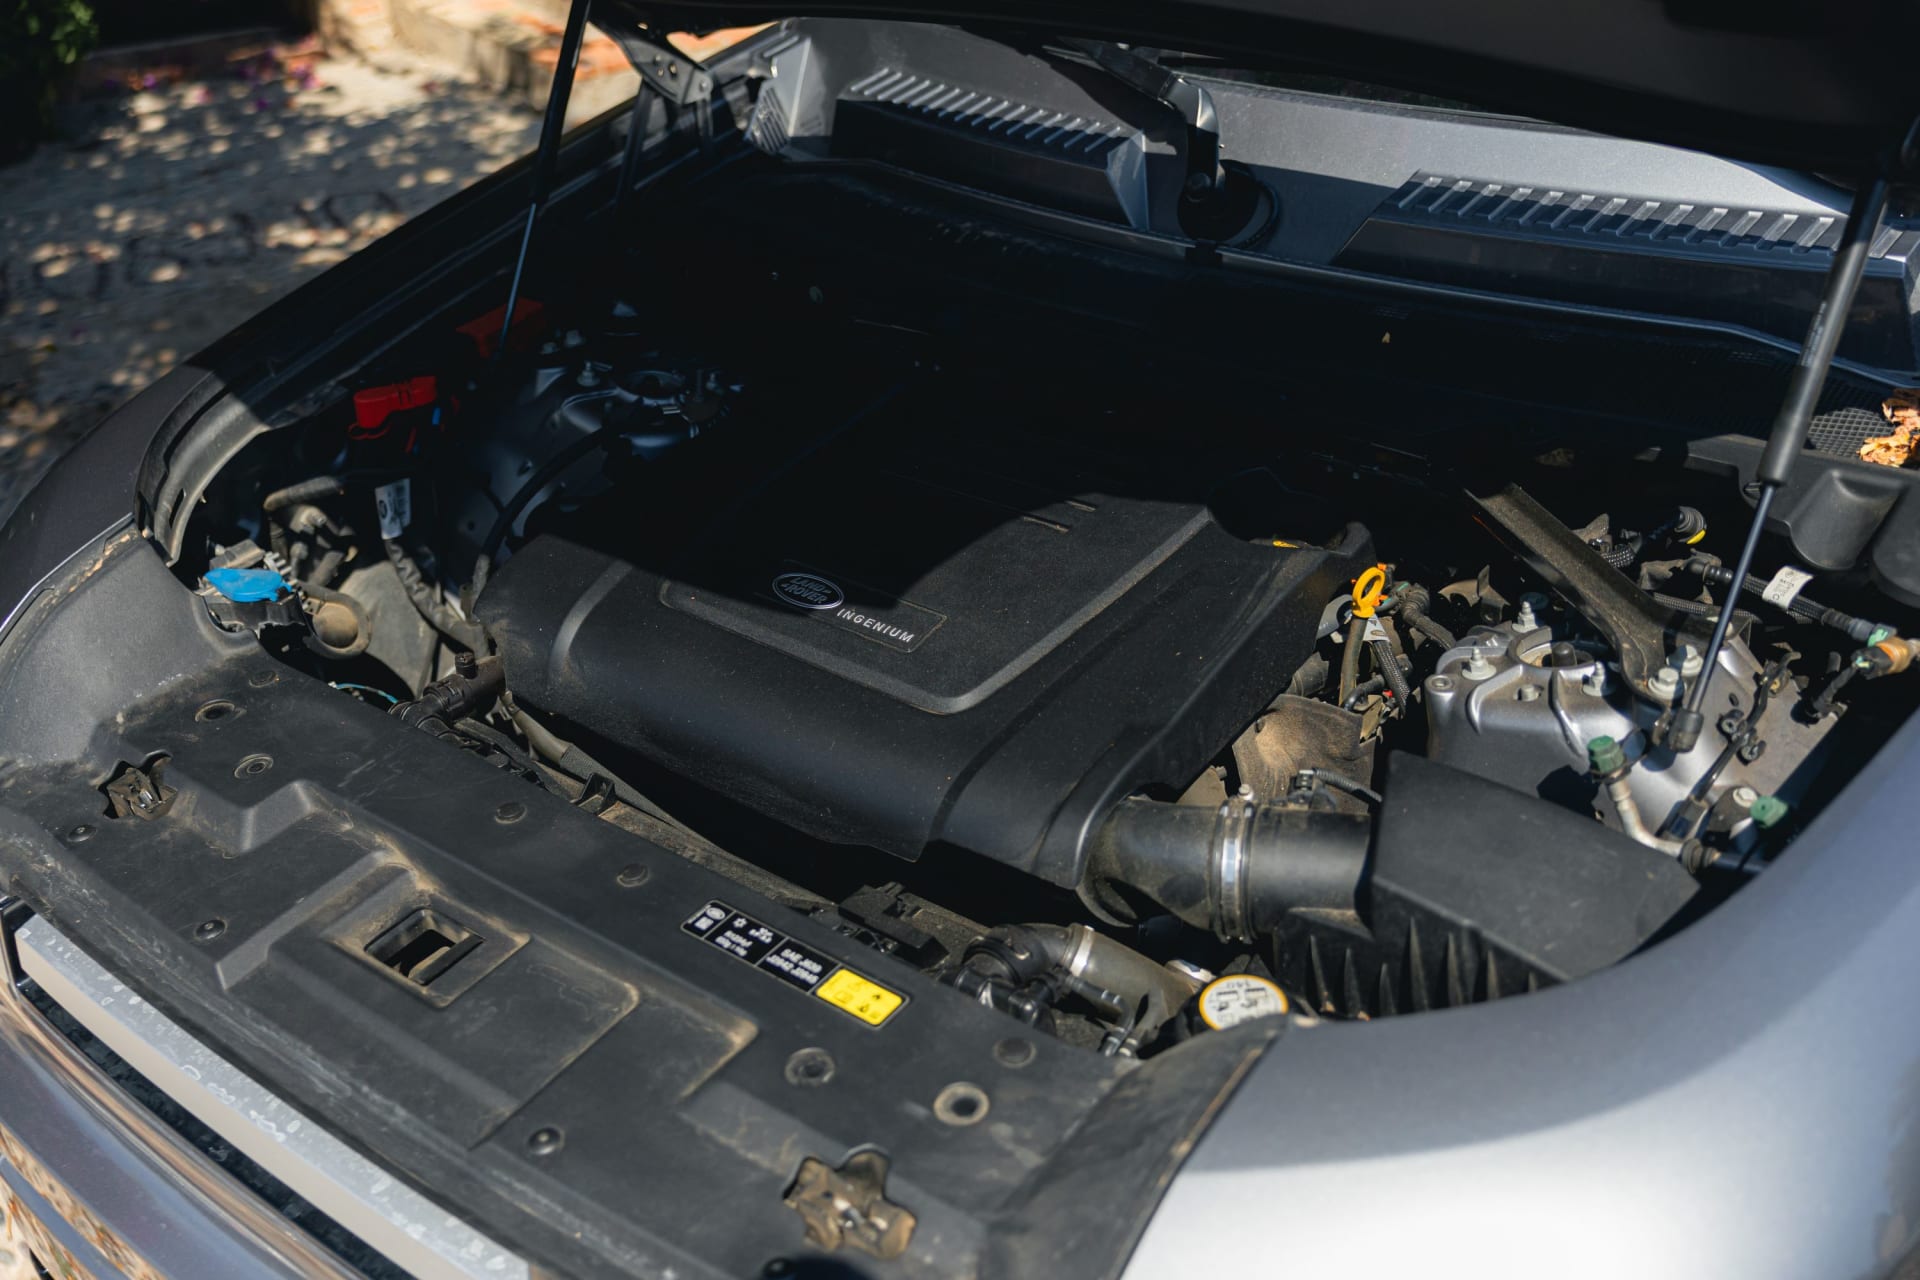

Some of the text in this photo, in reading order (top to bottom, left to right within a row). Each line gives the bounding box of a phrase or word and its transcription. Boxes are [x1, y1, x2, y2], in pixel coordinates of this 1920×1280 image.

[784, 583, 828, 604] ROVER
[790, 577, 826, 592] LAND
[837, 608, 915, 643] INGENIUM
